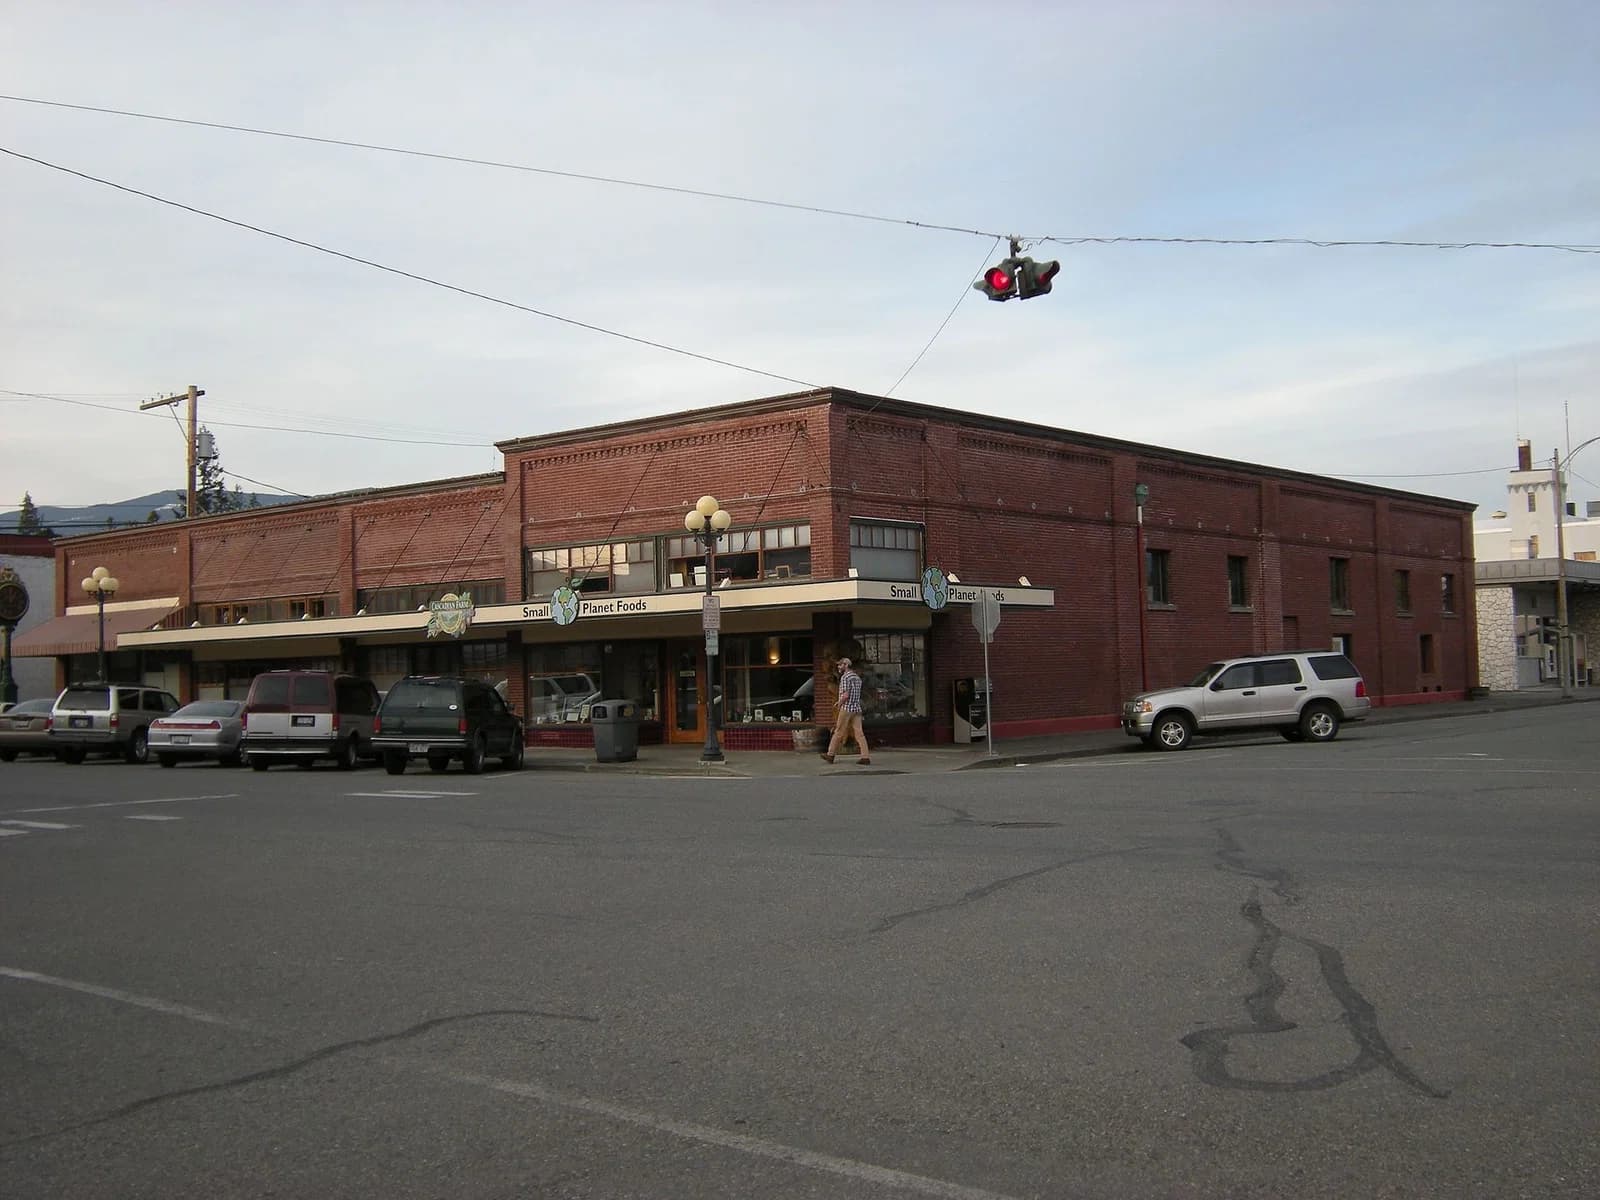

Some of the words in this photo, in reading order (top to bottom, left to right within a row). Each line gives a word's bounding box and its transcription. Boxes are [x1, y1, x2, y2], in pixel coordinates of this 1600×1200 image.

[890, 585, 917, 598] Small
[949, 588, 977, 601] Planet
[523, 606, 549, 618] Small
[582, 602, 614, 615] Planet
[616, 599, 647, 612] Foods
